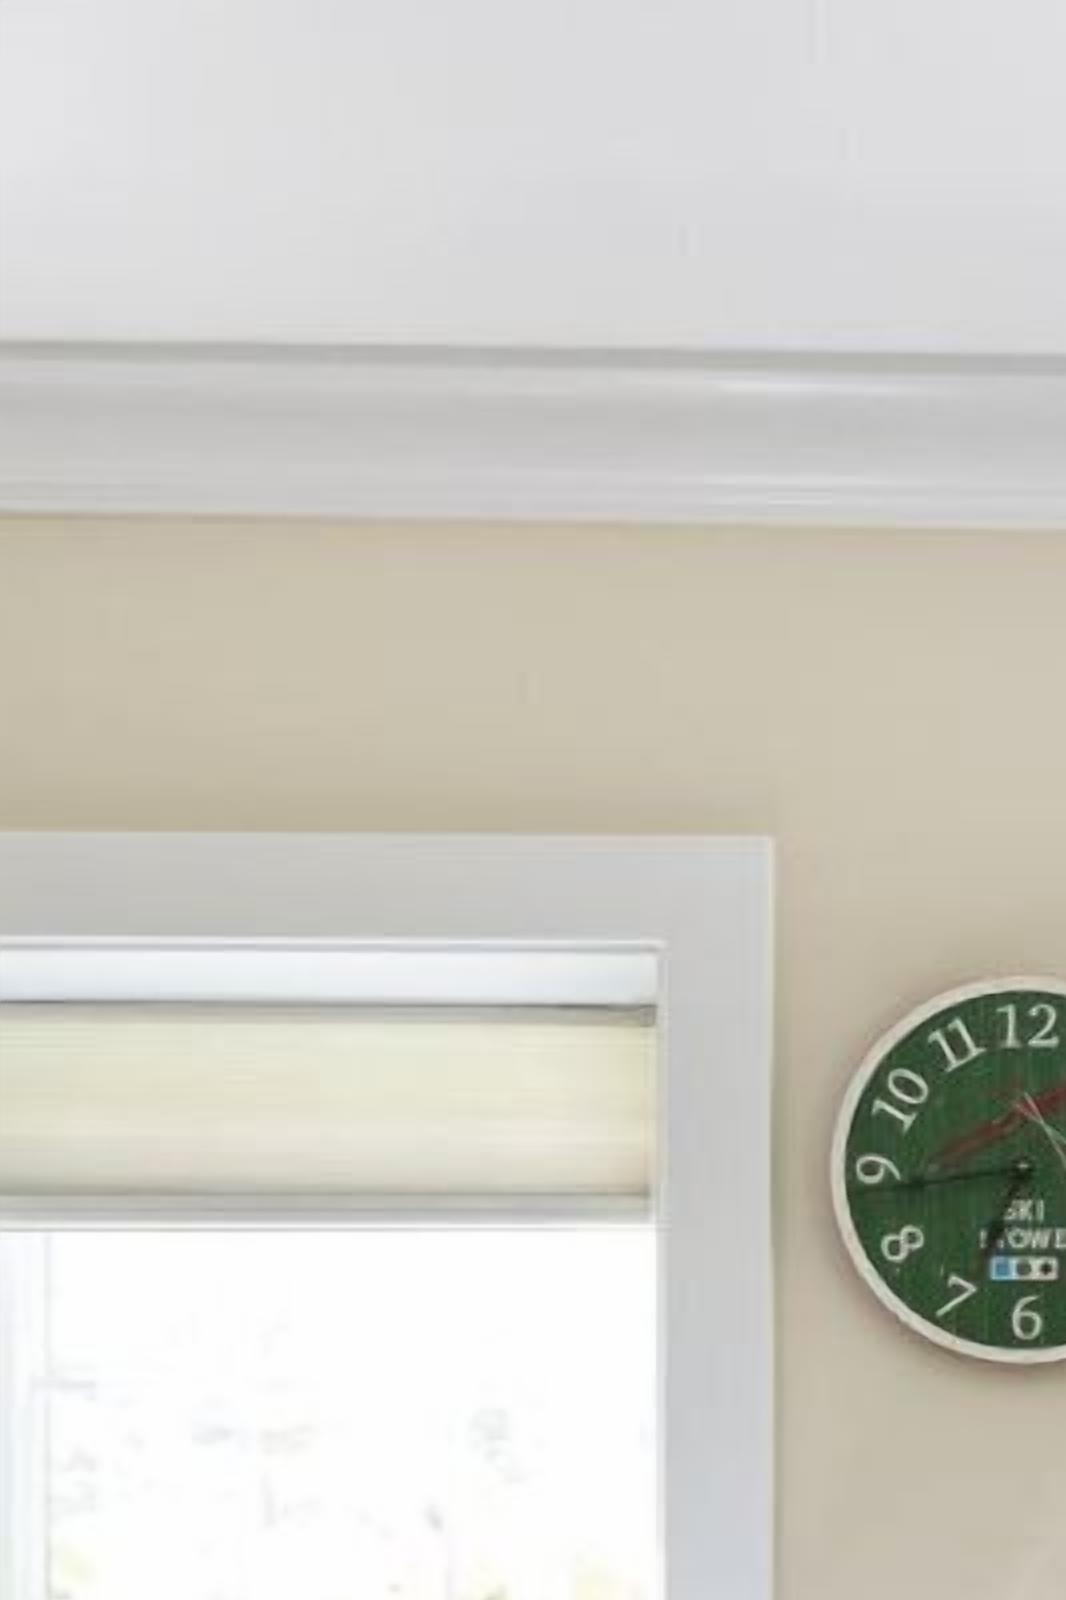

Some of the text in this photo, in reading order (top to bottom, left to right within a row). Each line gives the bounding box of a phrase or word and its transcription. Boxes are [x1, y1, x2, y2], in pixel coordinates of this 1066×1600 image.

[927, 1018, 987, 1074] 11
[996, 1003, 1060, 1048] 12
[871, 1067, 930, 1134] 10
[855, 1153, 903, 1185] 9
[1003, 1199, 1045, 1221] SKI
[880, 1224, 925, 1263] 8
[935, 1274, 977, 1317] 7
[1011, 1294, 1044, 1340] 6
